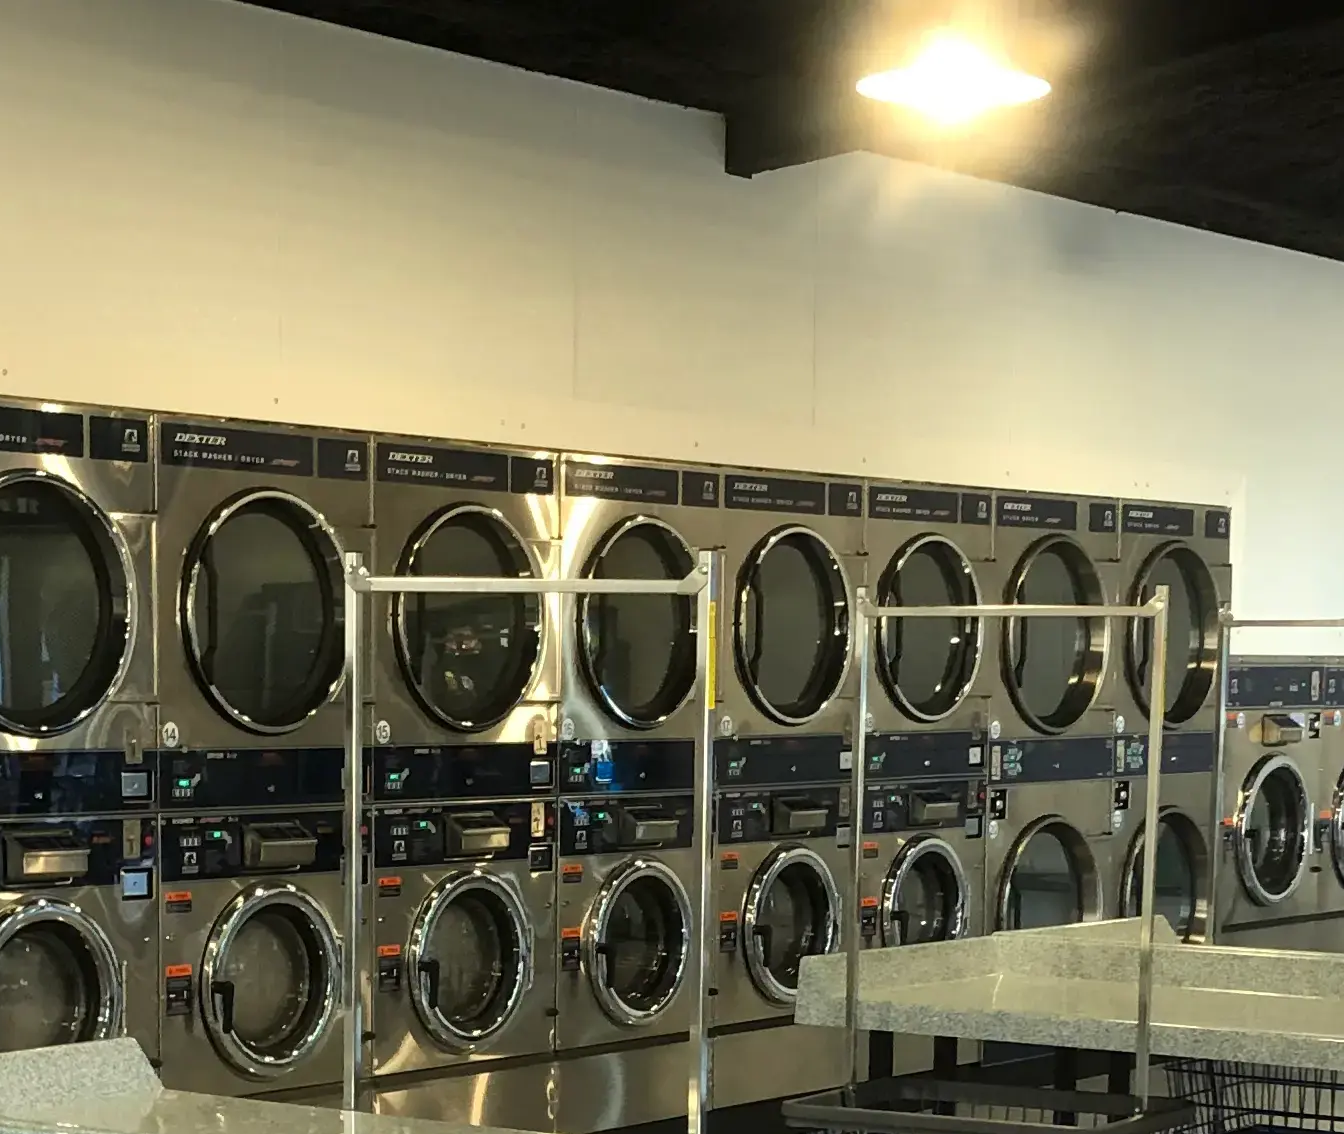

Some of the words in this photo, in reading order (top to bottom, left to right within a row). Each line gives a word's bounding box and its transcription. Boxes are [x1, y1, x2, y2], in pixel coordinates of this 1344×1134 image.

[175, 433, 227, 445] DEXTER
[389, 452, 433, 463] DEXTER
[164, 728, 176, 741] 14
[377, 725, 388, 738] 15
